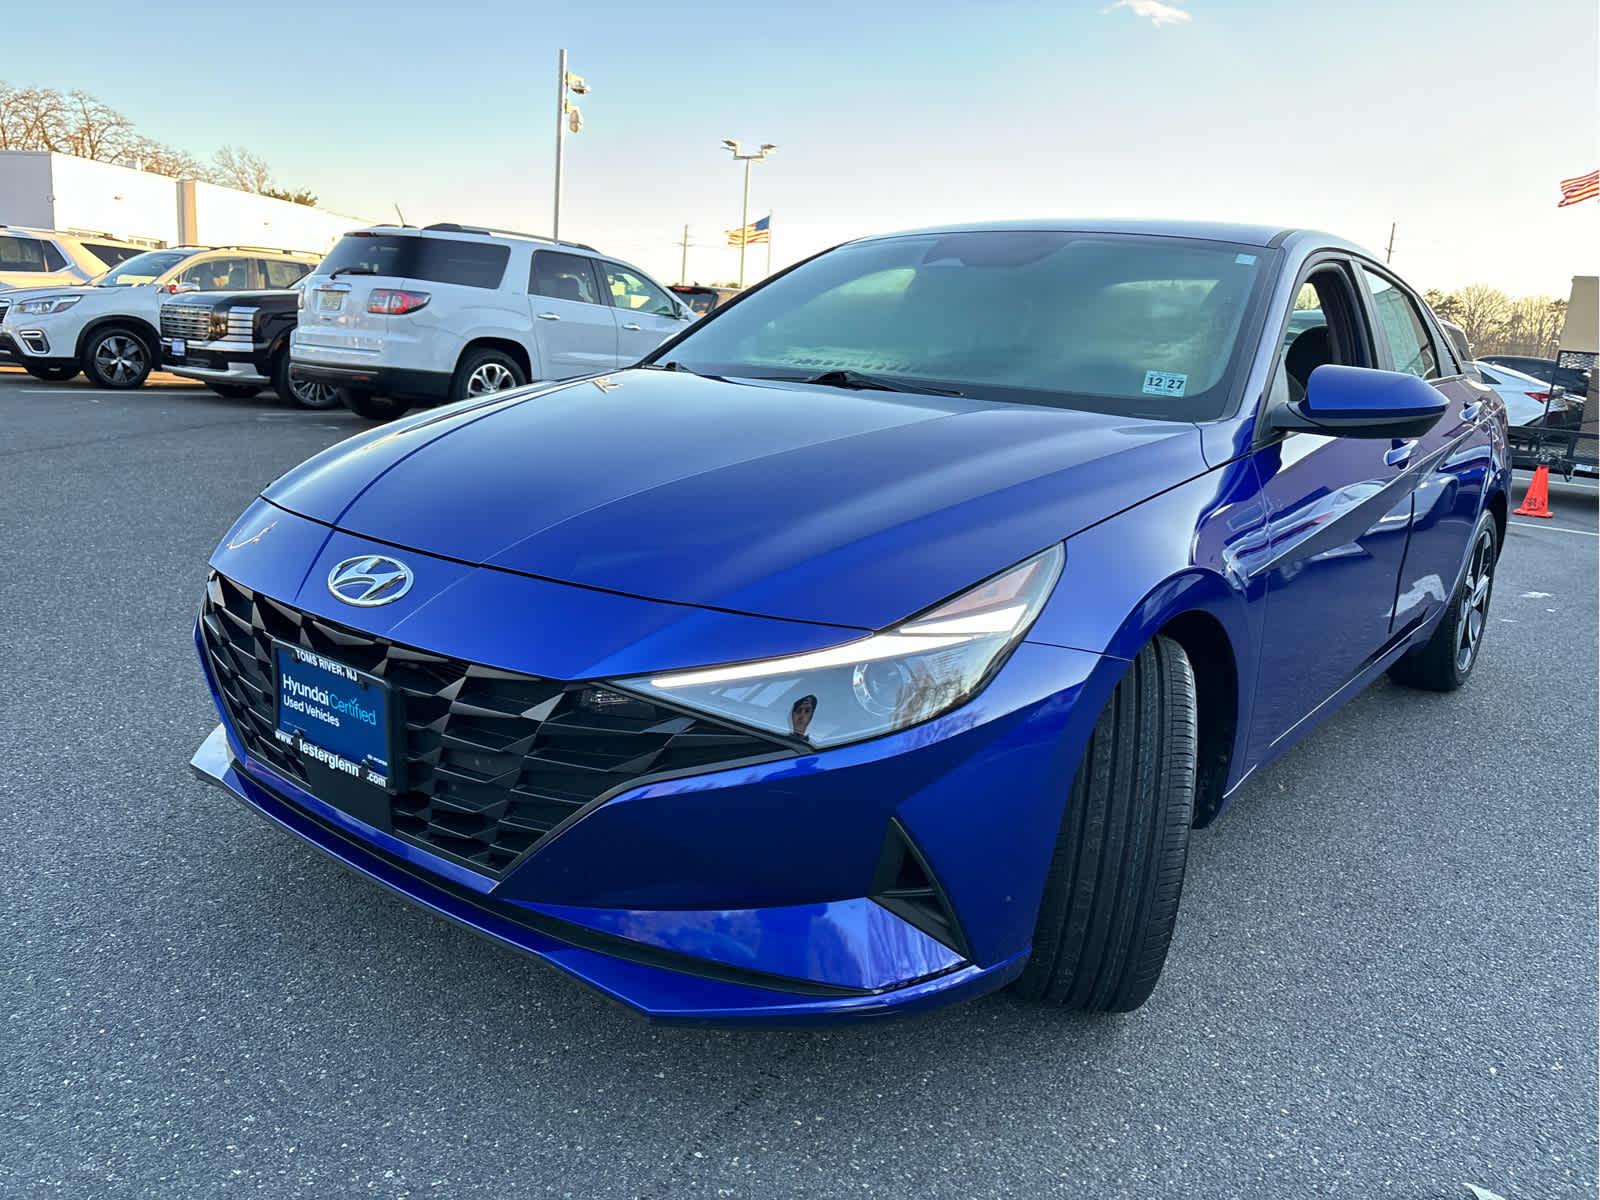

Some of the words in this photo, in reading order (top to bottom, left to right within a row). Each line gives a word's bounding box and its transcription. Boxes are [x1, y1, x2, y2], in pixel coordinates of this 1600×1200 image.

[1147, 376, 1164, 387] 12
[1167, 379, 1185, 390] 27
[295, 649, 318, 667] TOMS
[346, 669, 358, 682] NJ
[282, 673, 330, 706] Hyundai
[329, 693, 377, 726] Certified
[283, 694, 305, 713] Used
[305, 703, 340, 727] Vehicles
[299, 739, 360, 777] lesterglenn
[366, 773, 386, 788] .com
